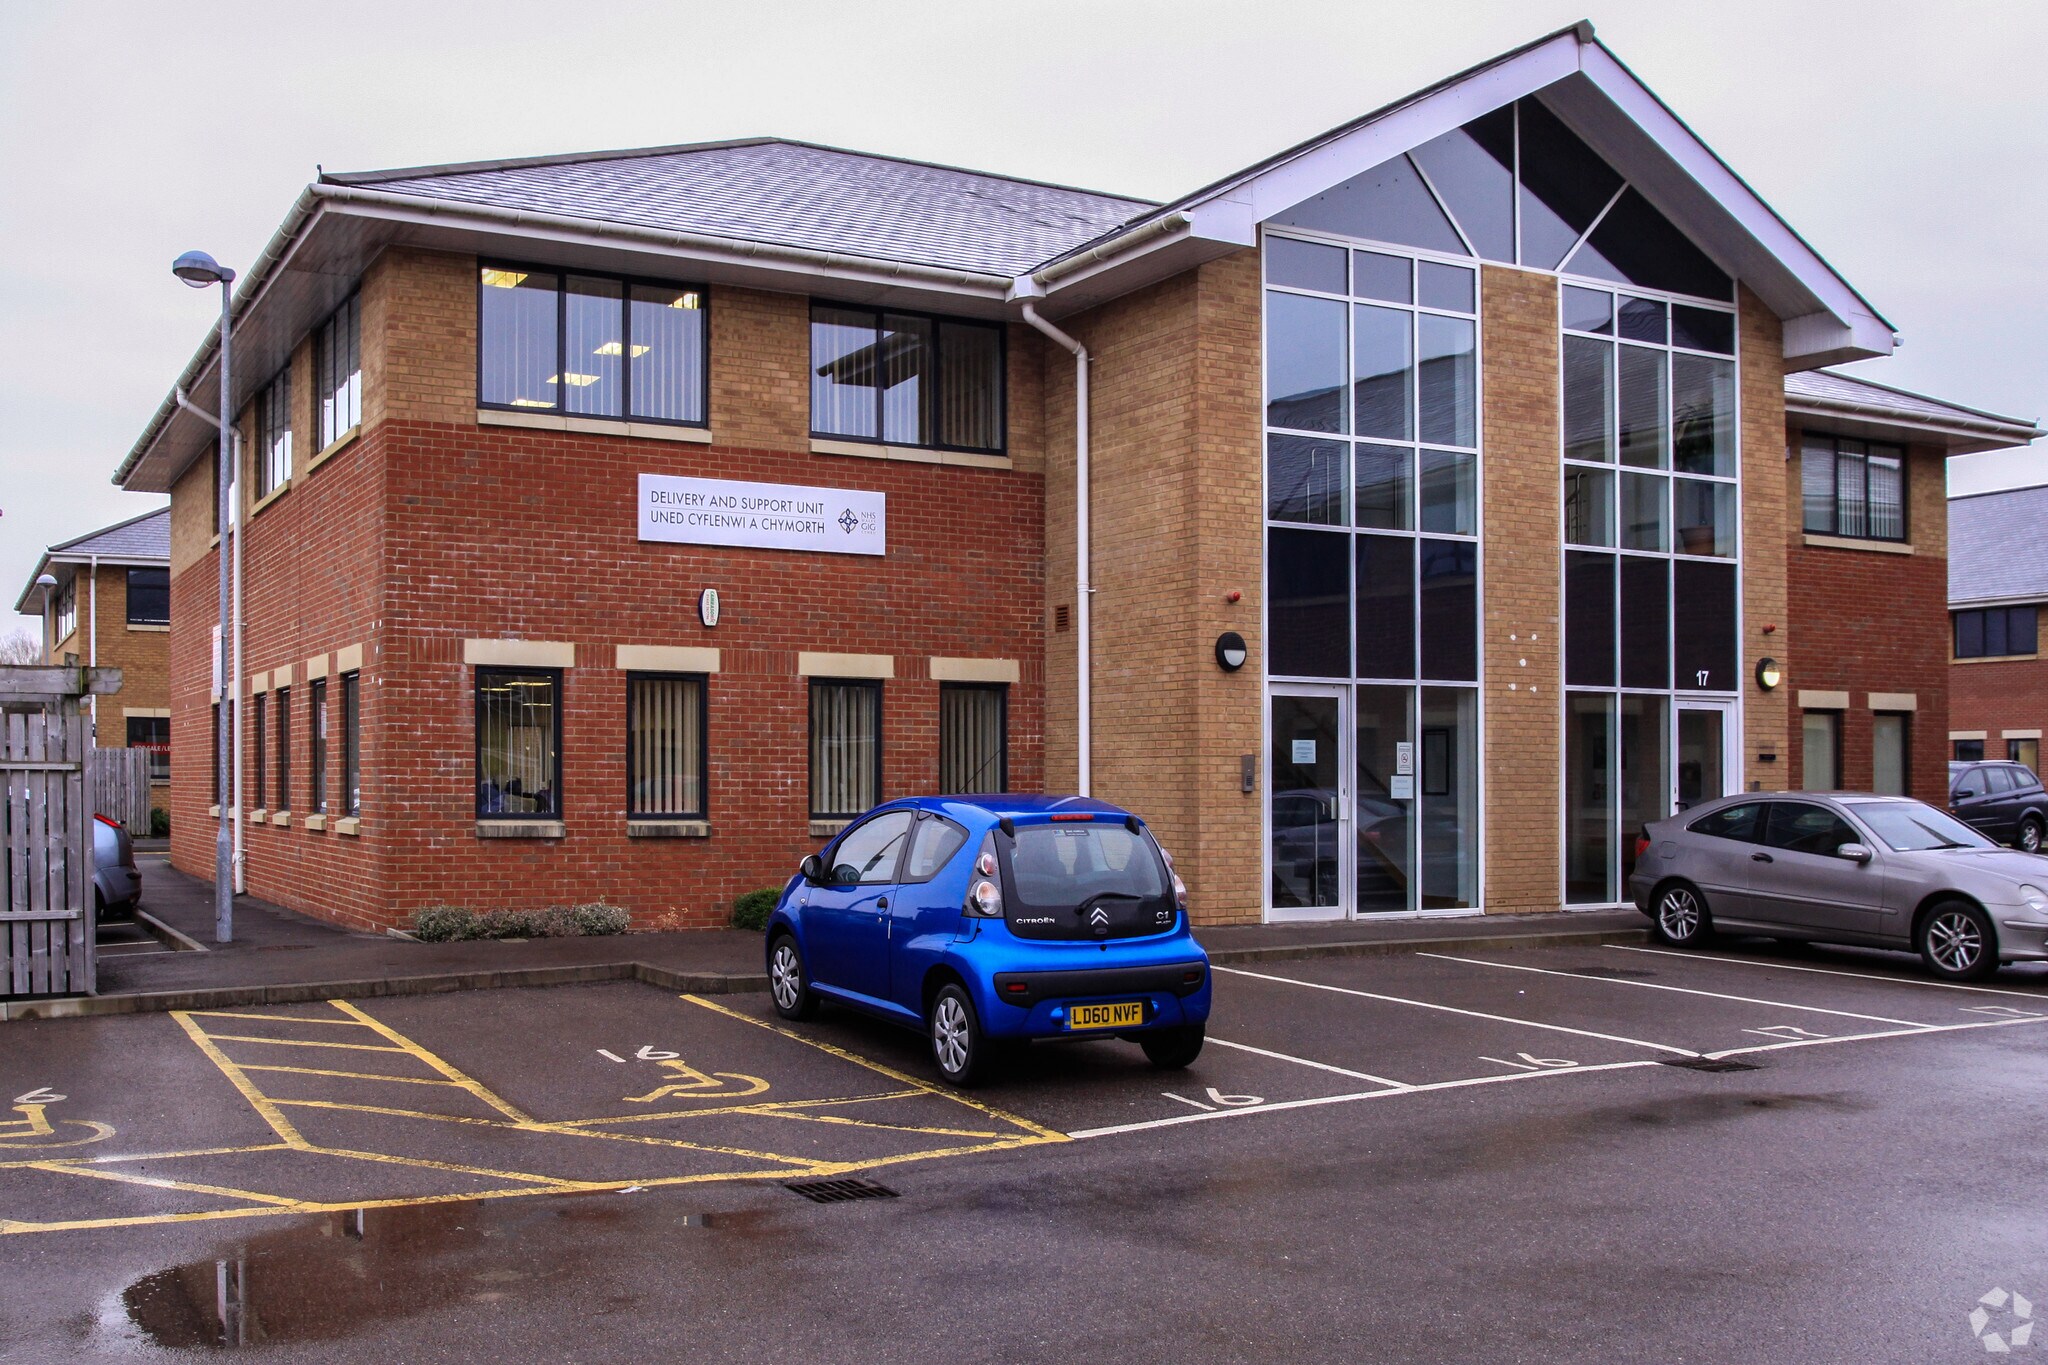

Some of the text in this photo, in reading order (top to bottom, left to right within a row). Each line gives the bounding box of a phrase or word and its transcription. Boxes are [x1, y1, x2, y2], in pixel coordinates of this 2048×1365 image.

[651, 490, 824, 515] DELIVERY AND SUPPORT UNIT
[650, 510, 825, 534] UNED CYFLENWI A CHYMORTH
[861, 511, 876, 519] NHS
[861, 522, 876, 531] GIG
[1696, 670, 1709, 686] 17
[1156, 911, 1169, 919] C1
[1073, 1004, 1140, 1025] LD60 NVF
[597, 1045, 681, 1063] 16
[1478, 1052, 1579, 1070] 16
[1161, 1087, 1265, 1111] 16
